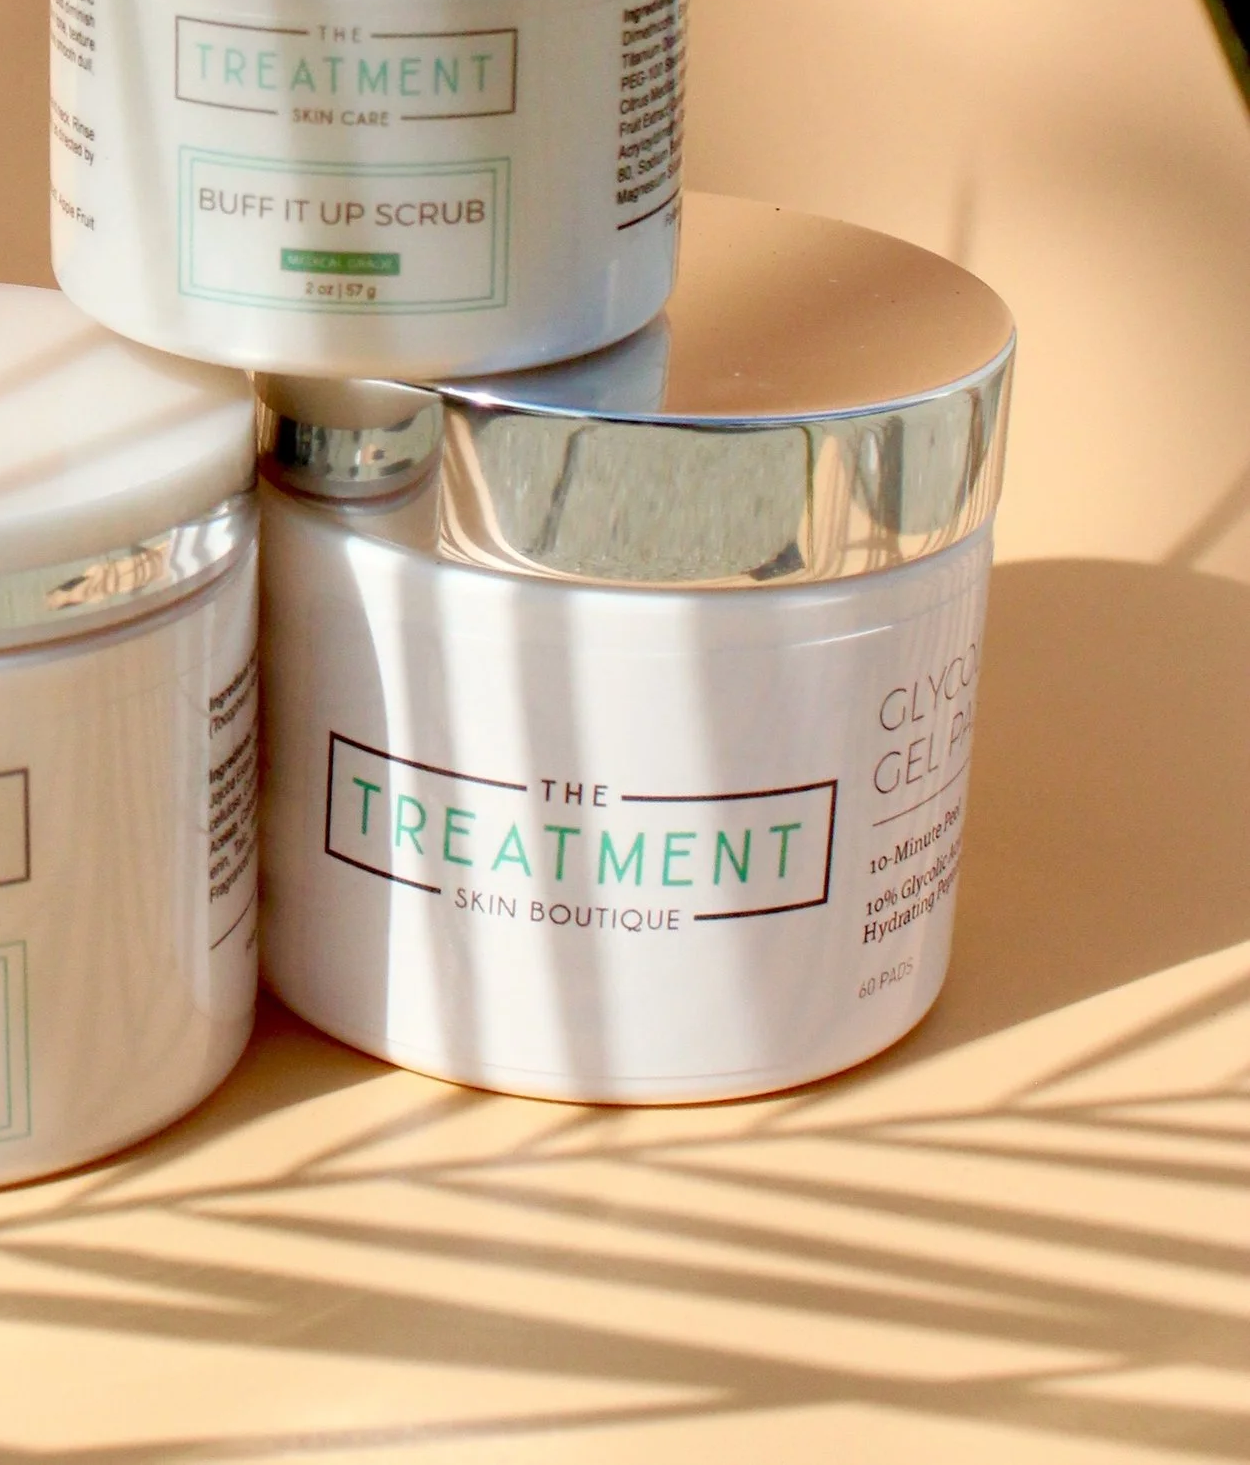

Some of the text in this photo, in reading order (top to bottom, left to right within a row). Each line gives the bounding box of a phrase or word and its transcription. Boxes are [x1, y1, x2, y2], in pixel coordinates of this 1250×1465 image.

[317, 25, 364, 43] THE
[195, 43, 493, 96] TREATMENT
[292, 108, 390, 127] SKIN CARE
[198, 187, 487, 227] BUFF IT UP SCRUB
[345, 283, 364, 297] 57
[879, 643, 979, 732] GLYCO
[873, 731, 939, 795] GEL
[540, 778, 609, 808] THE
[351, 777, 802, 887] TREATMENT
[869, 822, 942, 875] 10-Minute
[865, 888, 899, 918] 10%
[900, 852, 948, 902] Glycolic
[454, 888, 681, 933] SKIN BOUTIQUE
[861, 891, 935, 945] Hydrating
[878, 956, 915, 989] PADS
